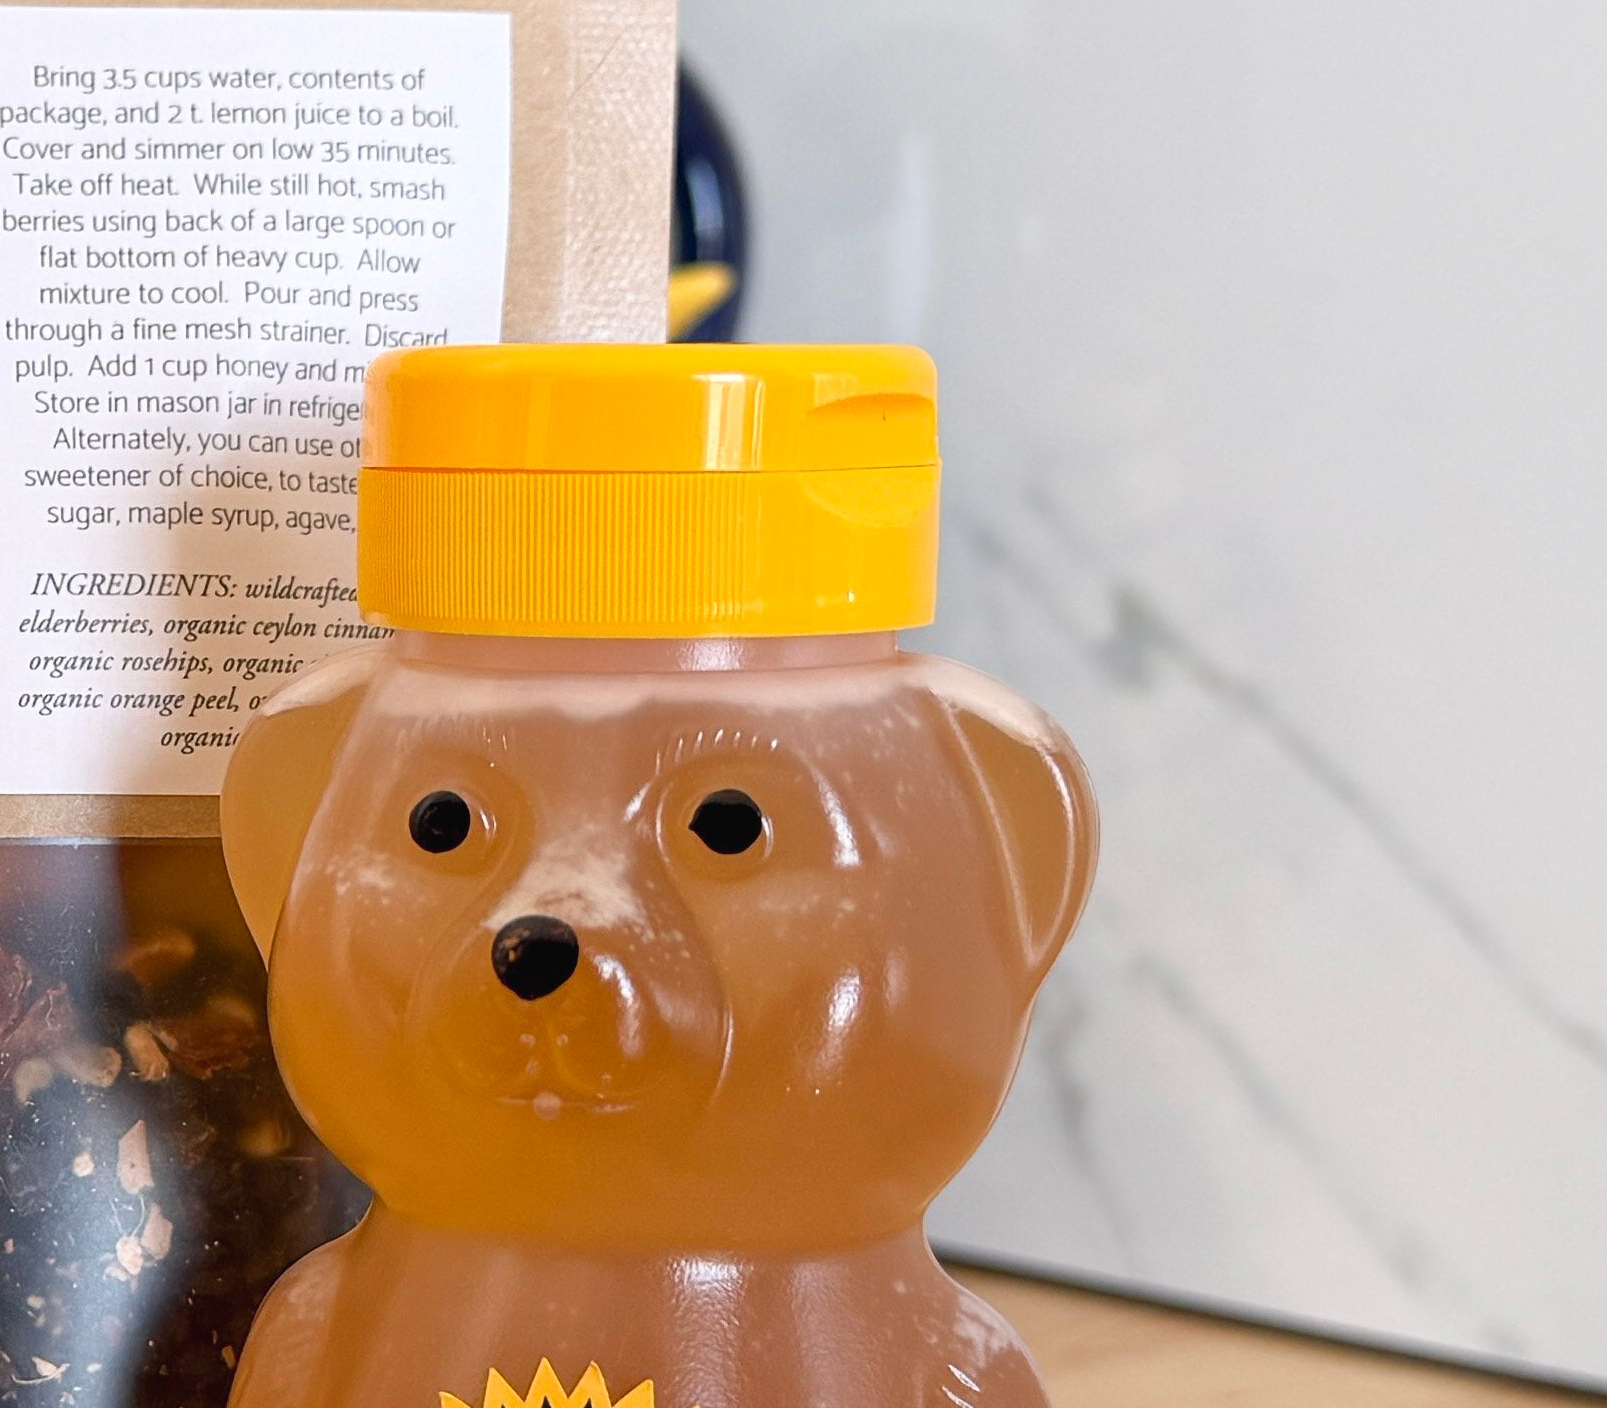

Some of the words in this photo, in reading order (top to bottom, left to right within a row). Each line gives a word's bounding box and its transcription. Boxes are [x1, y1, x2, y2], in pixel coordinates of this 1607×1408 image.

[34, 65, 95, 94] Bring
[104, 68, 137, 90] 3.5
[144, 71, 201, 93] cups
[209, 69, 282, 91] water,
[289, 69, 394, 90] contents
[401, 68, 425, 91] of
[0, 101, 107, 130] package,
[115, 101, 159, 124] and
[168, 105, 182, 124] 2
[190, 104, 203, 124] t.
[211, 102, 286, 124] lemon
[295, 103, 350, 130] juice
[359, 105, 382, 126] to
[390, 109, 404, 126] a
[413, 104, 458, 128] boil.
[3, 136, 73, 160] Cover
[81, 137, 126, 160] and
[135, 138, 225, 160] simmer
[233, 142, 263, 160] on
[272, 137, 314, 160] low
[321, 141, 350, 163] 35
[358, 143, 454, 165] minutes.
[12, 173, 72, 196] Take
[80, 173, 113, 196] off
[121, 173, 179, 196] heat.
[193, 173, 262, 196] While
[270, 173, 308, 196] still
[318, 173, 362, 199] hot,
[370, 178, 445, 200] smash
[3, 208, 84, 232] berries
[93, 210, 156, 238] using
[166, 209, 223, 232] back
[231, 208, 255, 232] of
[263, 215, 277, 231] a
[286, 209, 345, 239] large
[353, 217, 424, 239] spoon
[432, 221, 456, 239] or
[40, 245, 77, 268] flat
[86, 245, 175, 268] bottom
[184, 245, 208, 268] of
[216, 245, 288, 273] heavy
[295, 251, 343, 275] cup.
[357, 249, 420, 273] Allow
[40, 282, 130, 305] mixture
[139, 284, 164, 304] to
[171, 280, 228, 304] cool.
[245, 281, 301, 304] Pour
[309, 285, 351, 307] and
[360, 291, 418, 314] press
[5, 317, 102, 347] through
[111, 323, 124, 341] a
[133, 317, 177, 340] fine
[185, 317, 251, 340] mesh
[260, 320, 350, 345] strainer.
[16, 354, 73, 383] pulp.
[88, 353, 136, 377] Add
[145, 358, 153, 375] 1
[162, 359, 207, 382] cup
[216, 353, 289, 385] honey
[295, 359, 337, 382] and
[35, 390, 100, 414] Store
[108, 391, 128, 413] in
[137, 395, 219, 413] mason
[227, 391, 257, 419] jar
[264, 393, 282, 416] in
[289, 395, 362, 427] refrige
[53, 426, 191, 456] Alternately,
[197, 433, 241, 456] you
[248, 435, 288, 453] can
[295, 438, 333, 457] use
[24, 466, 151, 487] sweetener
[159, 463, 184, 487] of
[191, 464, 273, 492] choice,
[279, 470, 301, 491] to
[47, 506, 120, 530] sugar,
[129, 501, 204, 530] maple
[211, 507, 279, 532] syrup,
[286, 511, 355, 535] agave,
[30, 572, 237, 598] INGREDIENTS:
[19, 609, 153, 636] elderberries,
[163, 614, 247, 642] organic
[253, 613, 317, 644] ceylon
[29, 650, 114, 678] organic
[121, 647, 213, 679] rosehips,
[223, 653, 304, 681] organic
[18, 687, 103, 716] organic
[110, 694, 185, 717] orange
[188, 686, 239, 717] peel,
